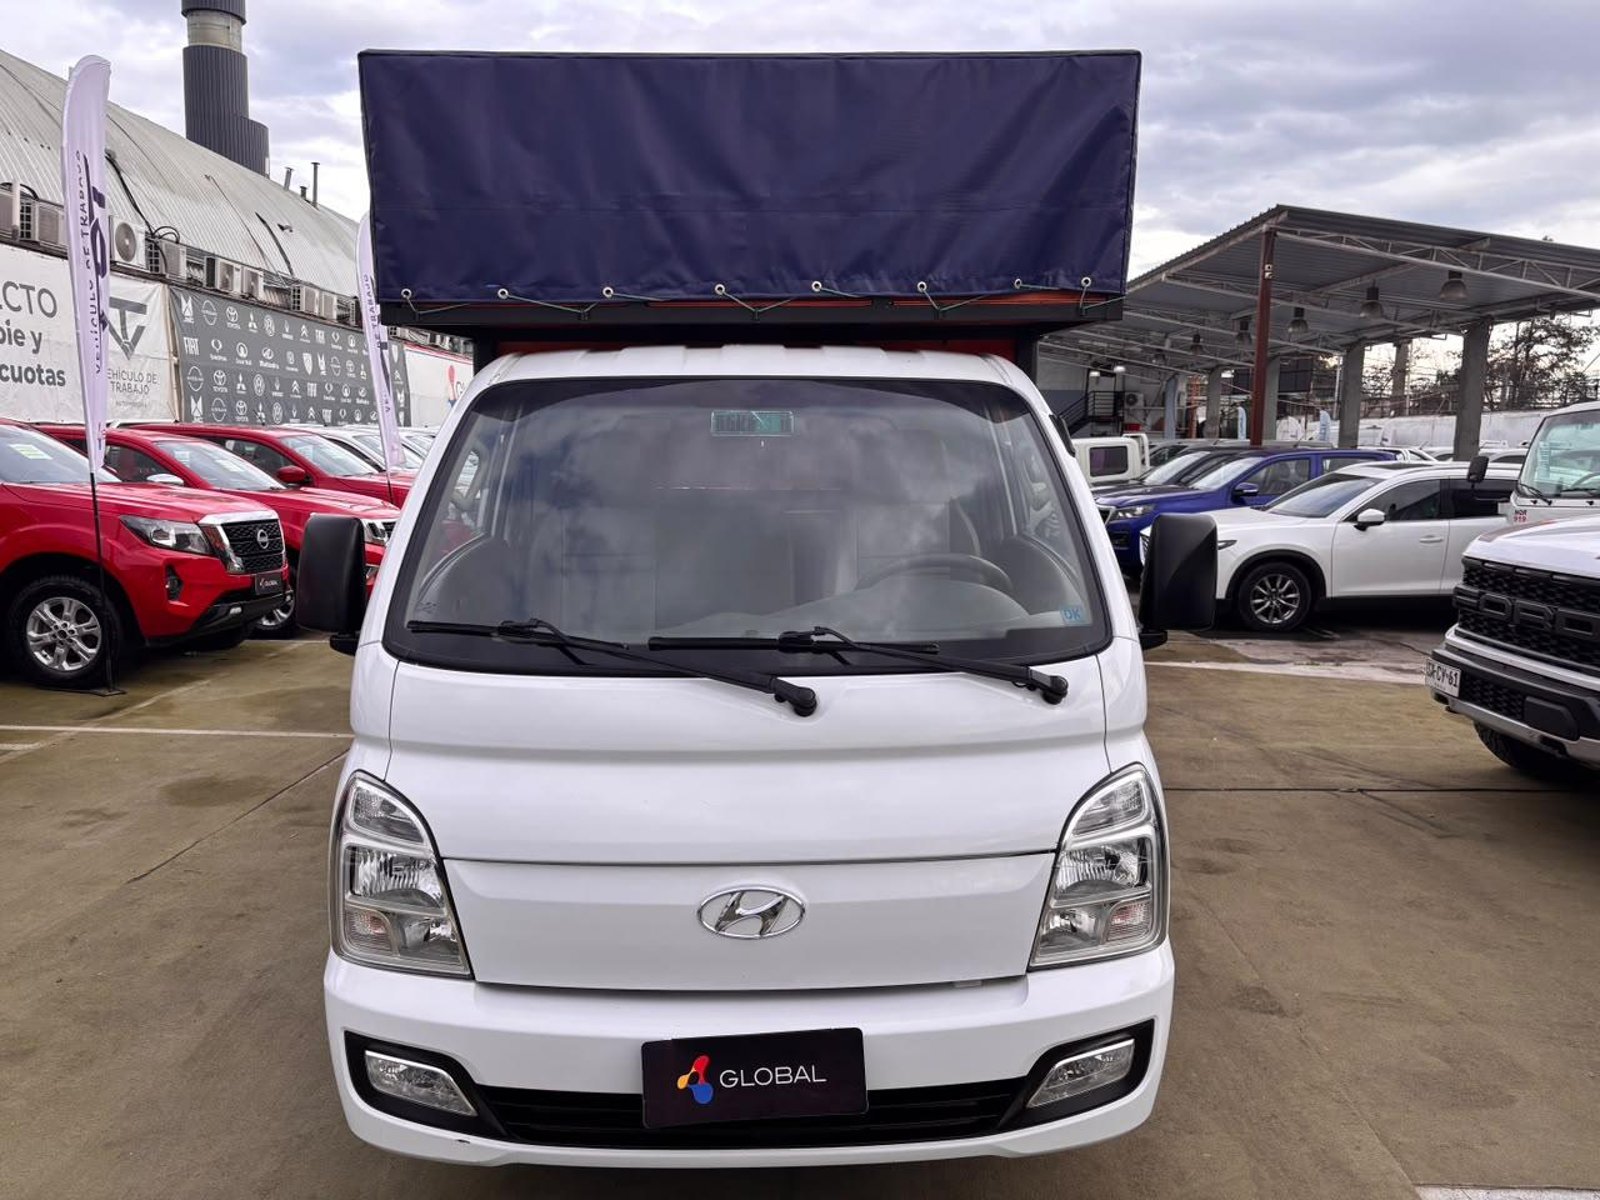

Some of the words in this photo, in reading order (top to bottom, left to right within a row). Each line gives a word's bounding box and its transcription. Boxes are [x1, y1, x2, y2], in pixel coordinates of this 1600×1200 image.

[0, 281, 57, 318] CTO
[30, 329, 42, 355] y
[0, 363, 66, 387] cuotas
[107, 366, 144, 383] EHÍCULO
[146, 372, 158, 384] DE
[110, 381, 150, 395] TRABAJO
[719, 1065, 827, 1088] GLOBAL
